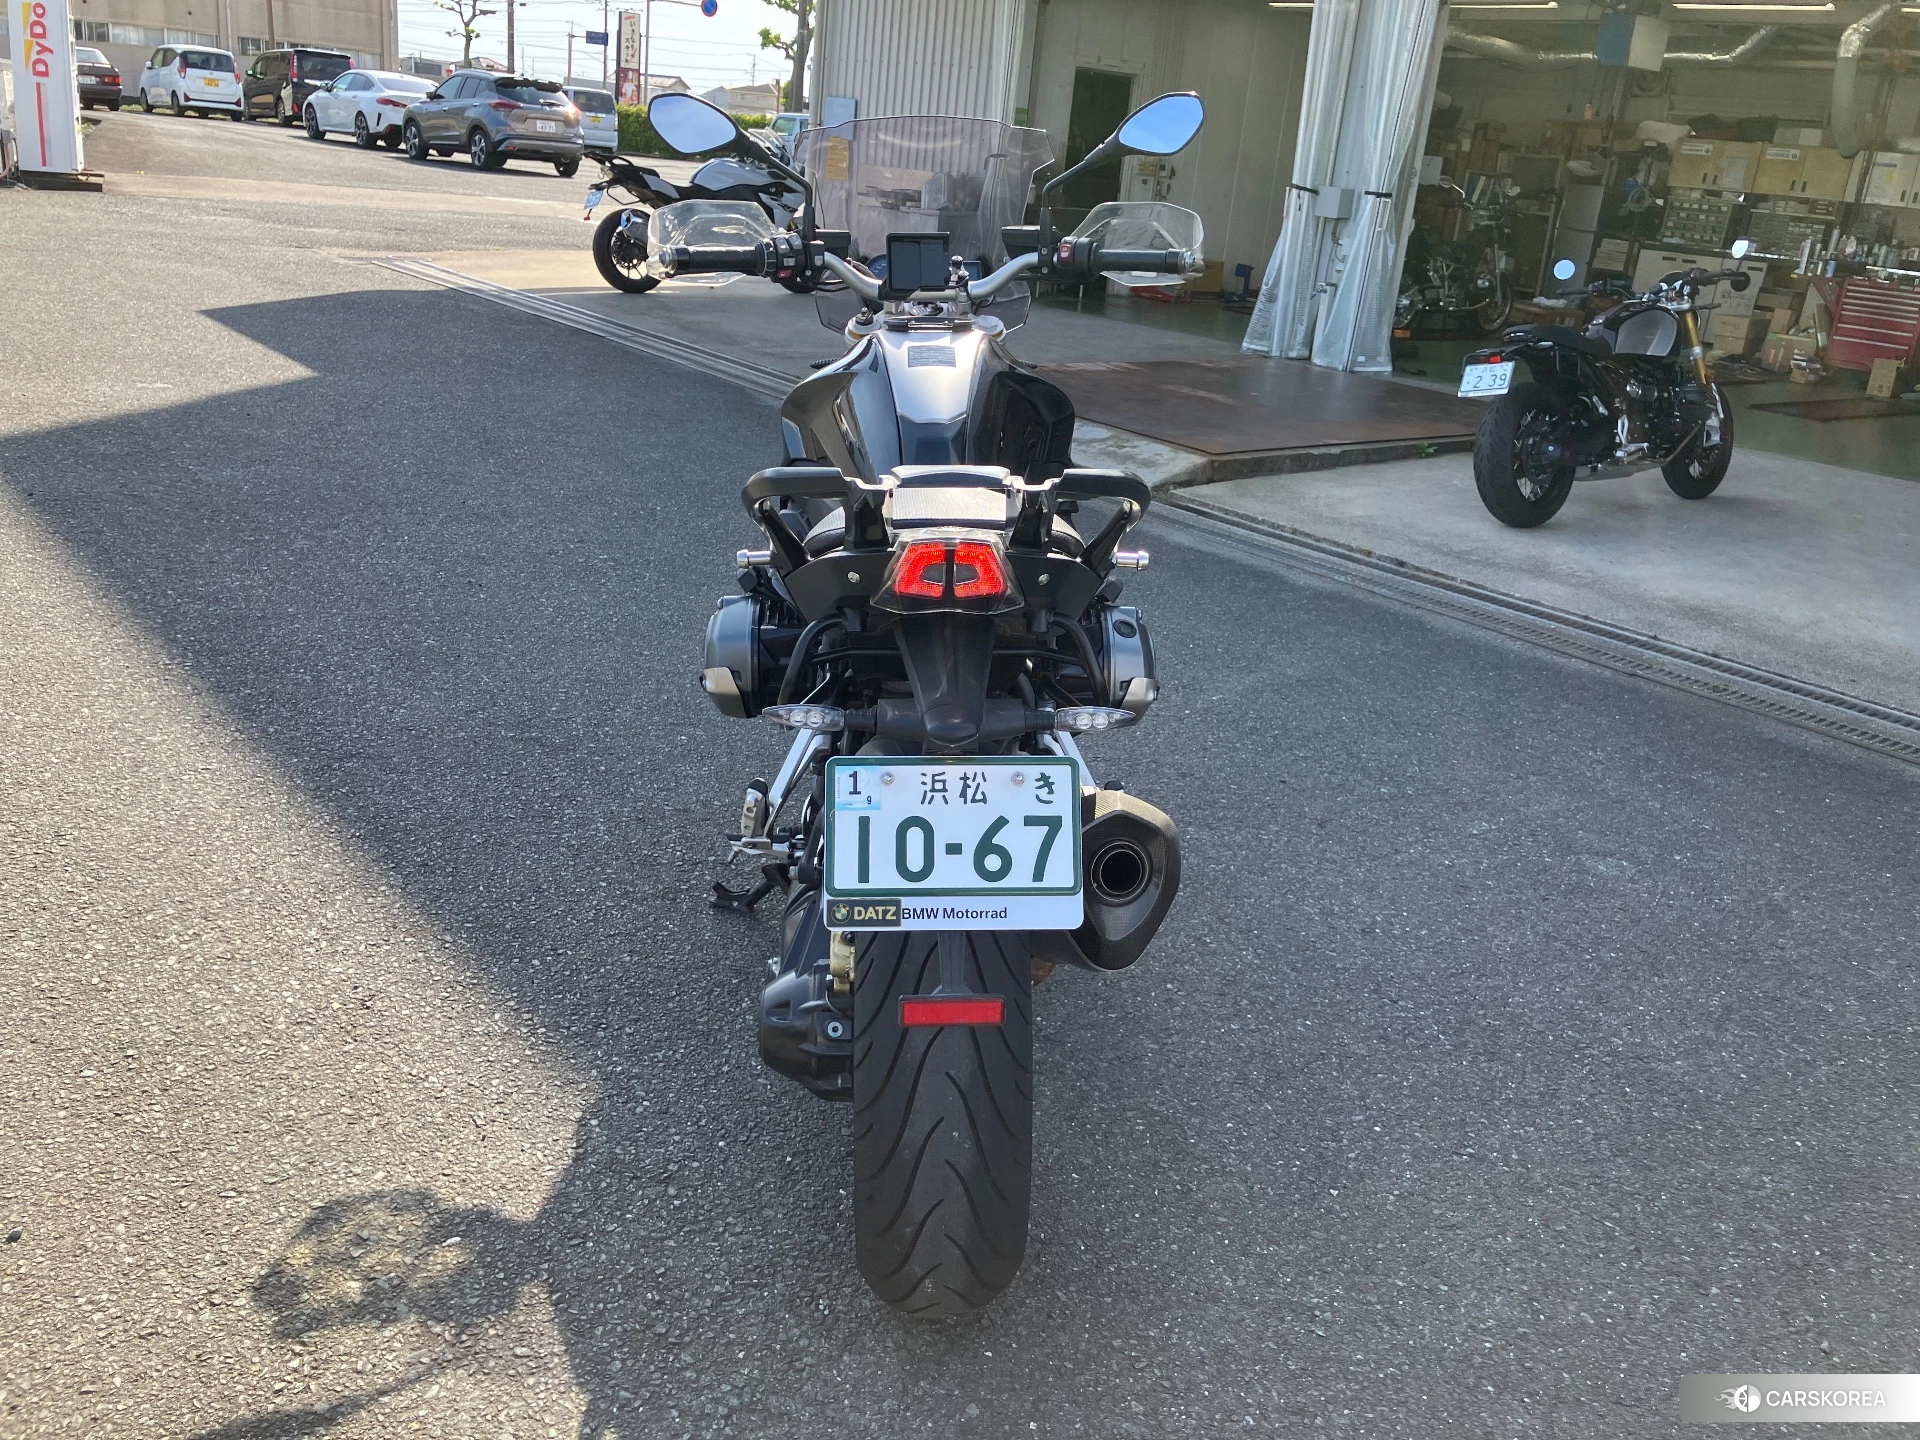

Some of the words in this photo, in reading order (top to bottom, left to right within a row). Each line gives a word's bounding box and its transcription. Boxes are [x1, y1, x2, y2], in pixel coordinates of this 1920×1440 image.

[30, 2, 54, 78] DyDo
[849, 771, 862, 795] 1
[920, 771, 988, 805] 浜松
[1034, 772, 1056, 805] き
[866, 795, 872, 805] 9
[857, 815, 1063, 884] 10-67
[853, 906, 897, 920] DATZ
[902, 907, 939, 920] BMW
[943, 907, 1008, 919] Motorrad
